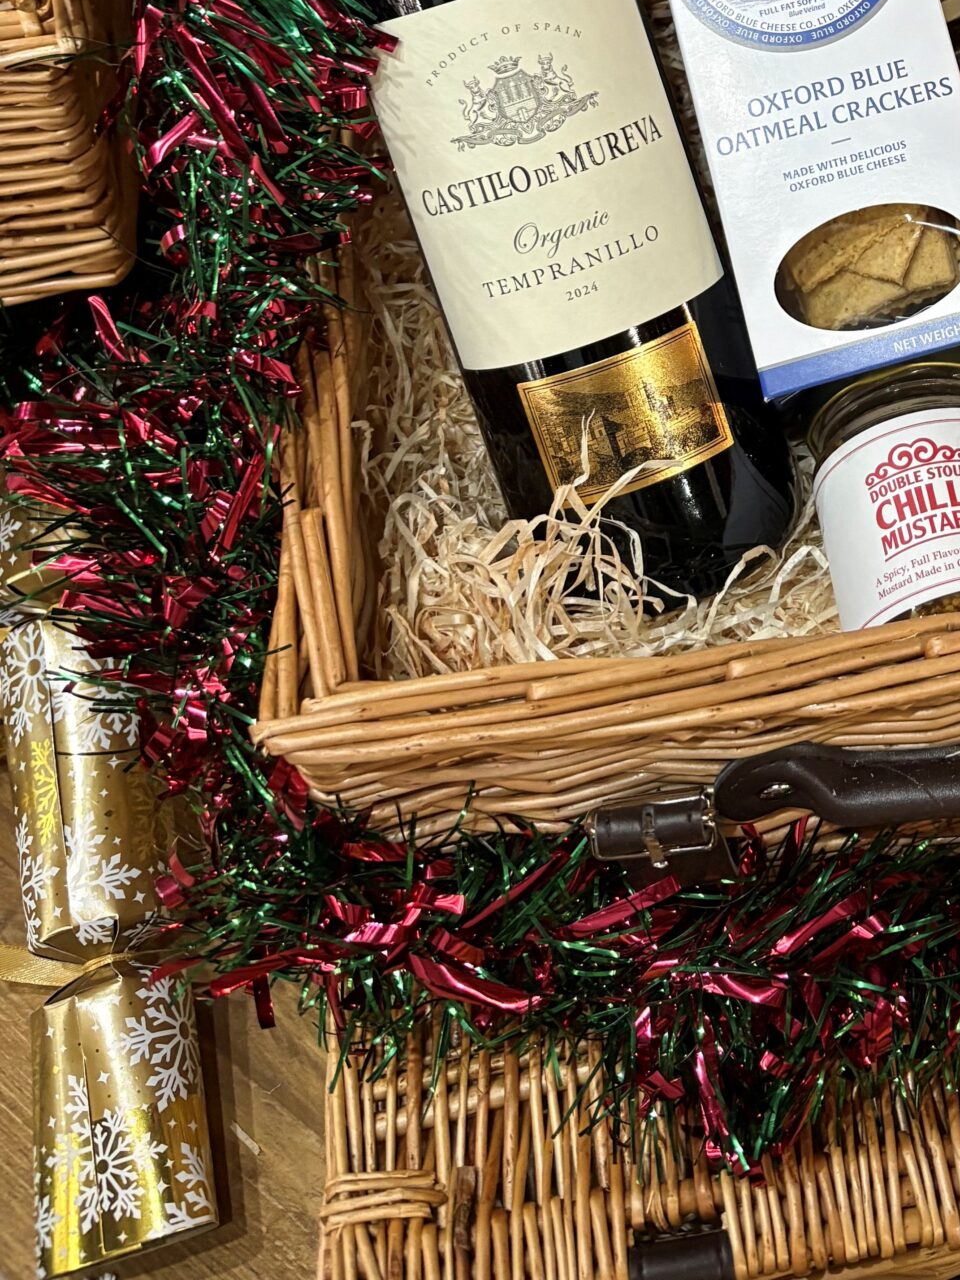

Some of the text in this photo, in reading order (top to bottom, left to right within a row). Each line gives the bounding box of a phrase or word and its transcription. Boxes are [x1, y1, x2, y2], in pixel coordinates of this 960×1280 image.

[735, 12, 759, 28] BLUE
[760, 22, 797, 32] CHEESE
[800, 20, 816, 30] CO.
[817, 12, 838, 25] LTD.
[759, 6, 779, 17] FULL
[780, 2, 795, 11] FAT
[788, 3, 826, 18] Blue Veined
[425, 22, 582, 87] PRODUCT OF SPAIN
[747, 59, 909, 118] OXFORD BLUE
[716, 111, 828, 156] OATMEAL
[831, 77, 954, 124] CRACKERS
[422, 114, 663, 216] CASTILLO DE MUREVA
[782, 140, 907, 182] MADE WITH DELICIOUS
[789, 153, 907, 193] OXFORD BLUE CHEESE
[513, 209, 610, 259] Organic
[482, 225, 659, 298] TEMPRANILLO
[566, 281, 599, 301] 2024
[893, 337, 918, 353] NET
[869, 470, 923, 503] DOUBLE
[875, 578, 882, 587] A
[883, 565, 910, 581] Spicy,
[911, 554, 931, 568] Full
[878, 576, 913, 600] Mustard
[915, 566, 942, 581] Made
[944, 562, 955, 571] in
